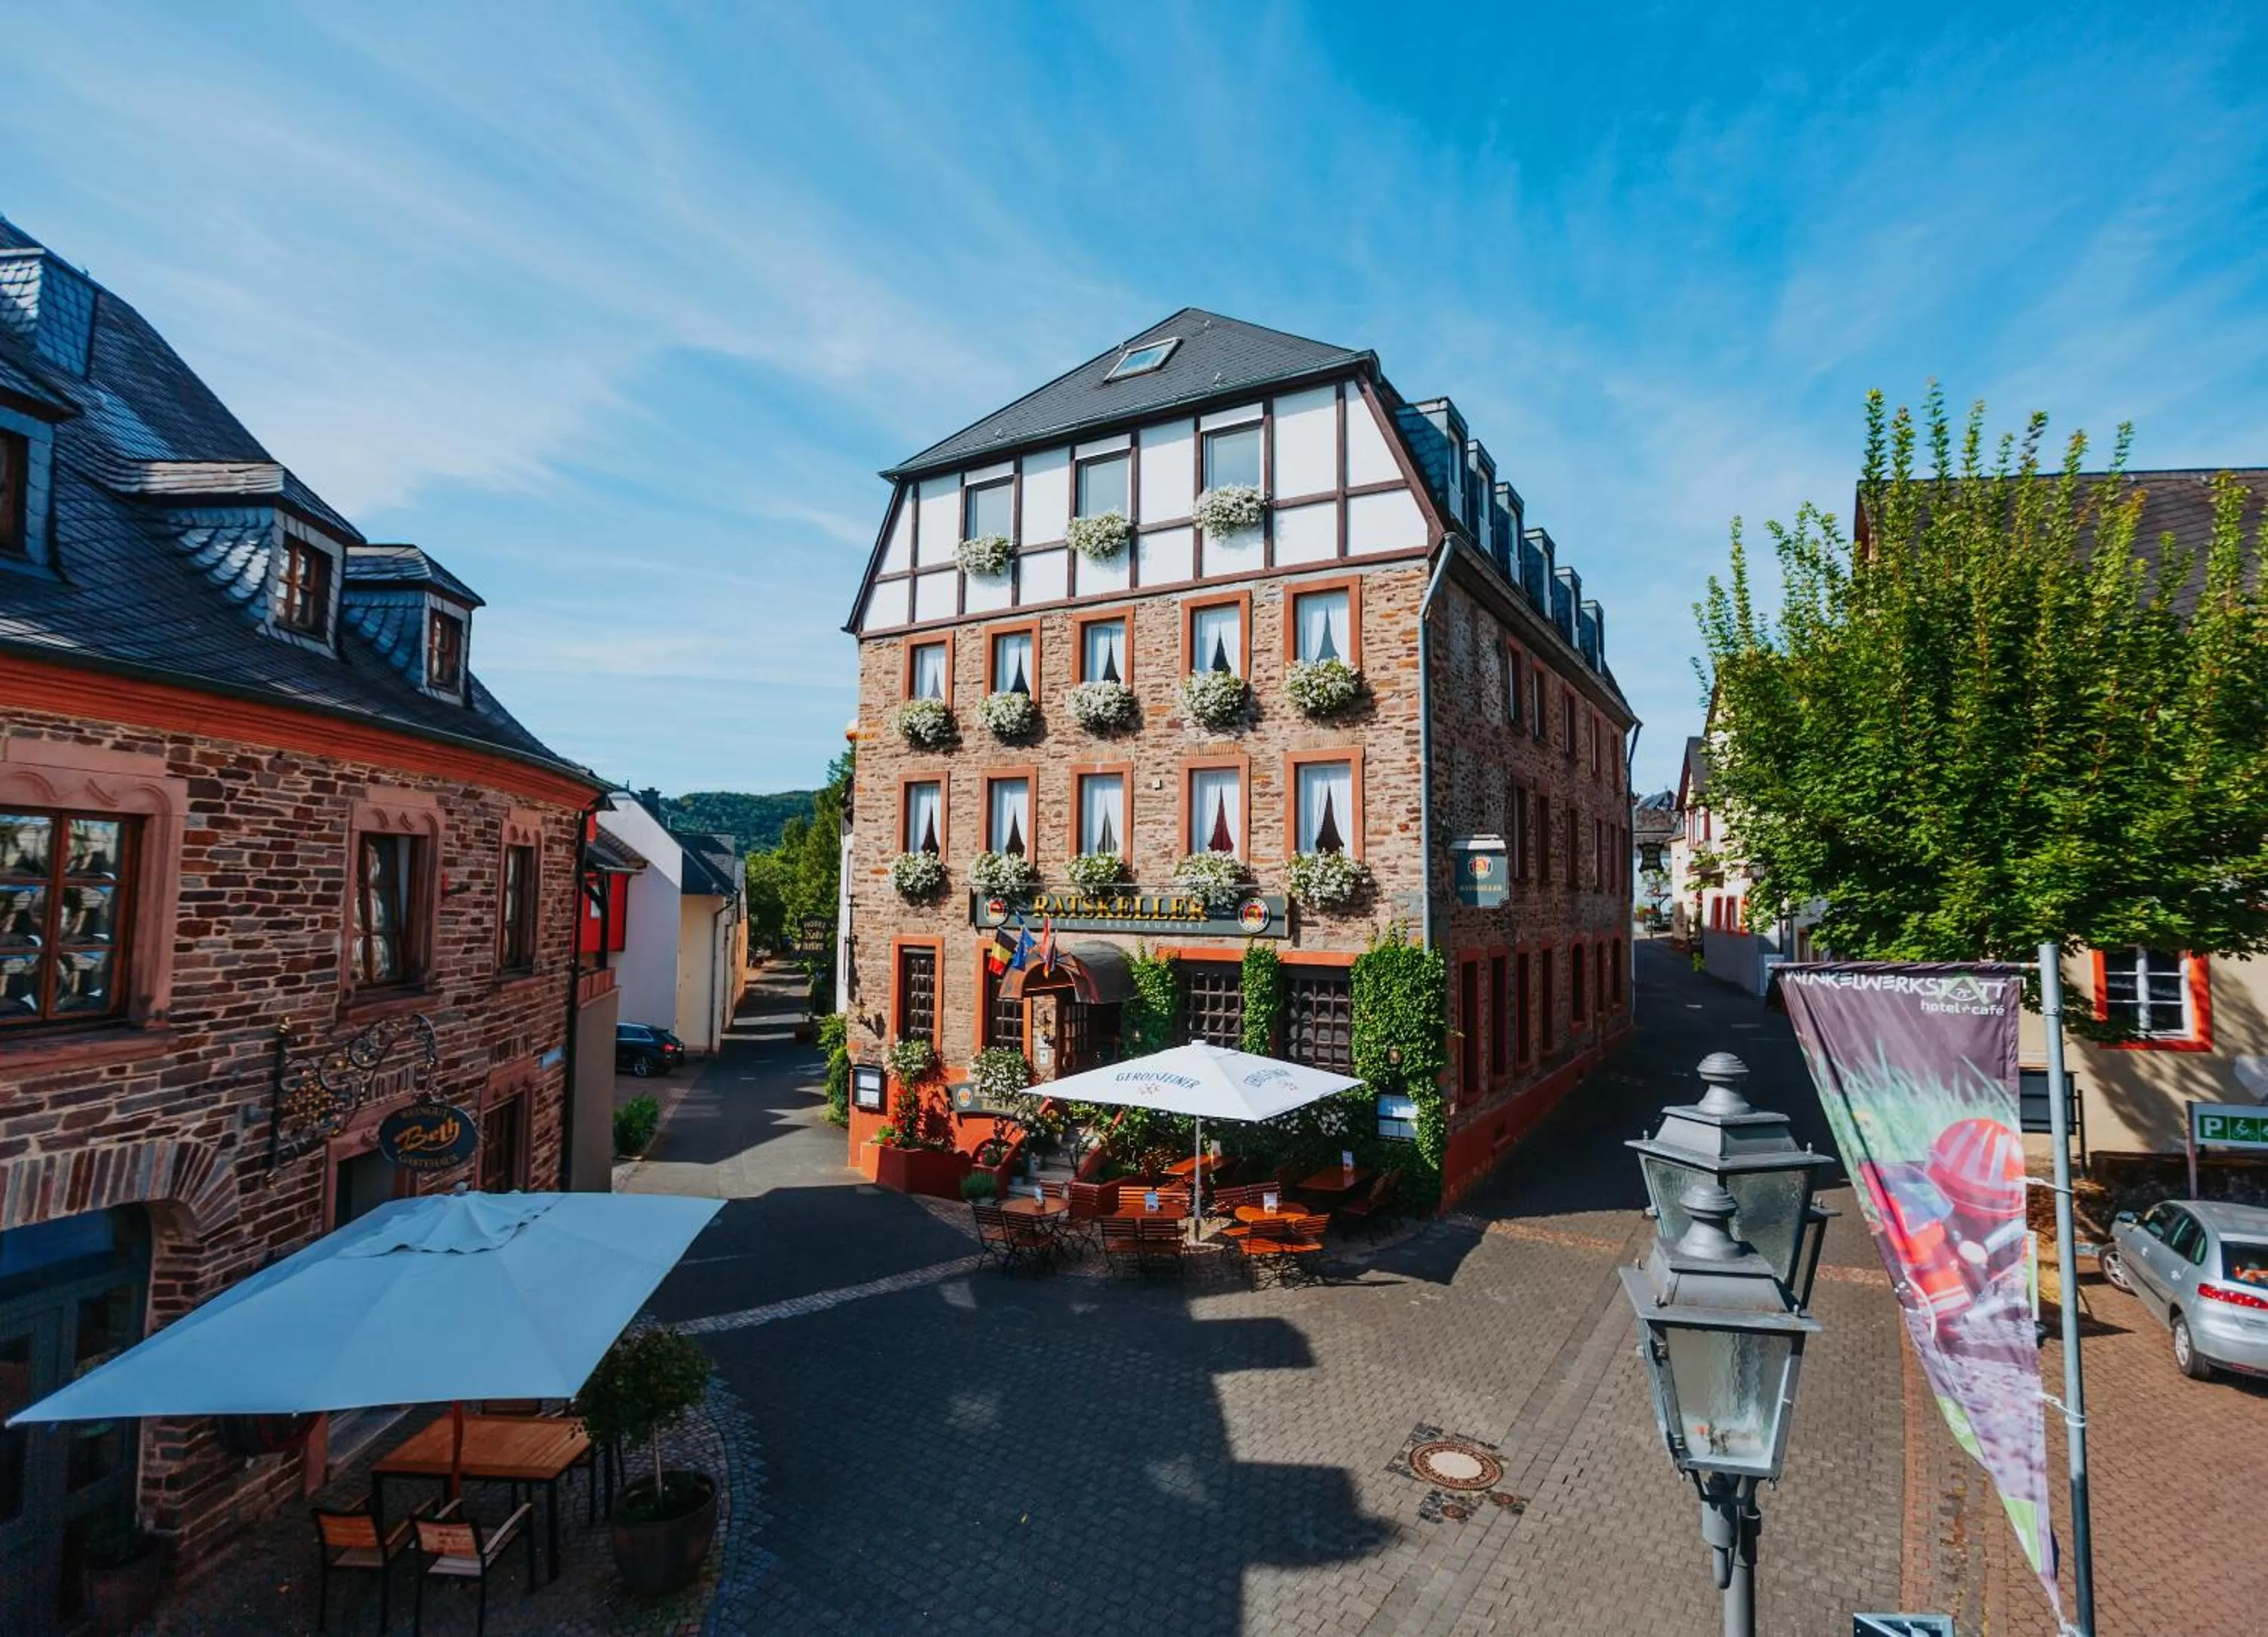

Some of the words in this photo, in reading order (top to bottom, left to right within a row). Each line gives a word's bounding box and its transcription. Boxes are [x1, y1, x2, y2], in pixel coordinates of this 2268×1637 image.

[1033, 895, 1208, 921] RATSKELLER
[1106, 921, 1204, 930] RESTAURANT
[1785, 971, 2007, 1004] WINKELWERKSTATT
[1920, 999, 1960, 1013] hotel
[1971, 1004, 2005, 1016] café
[2204, 1117, 2223, 1137] P
